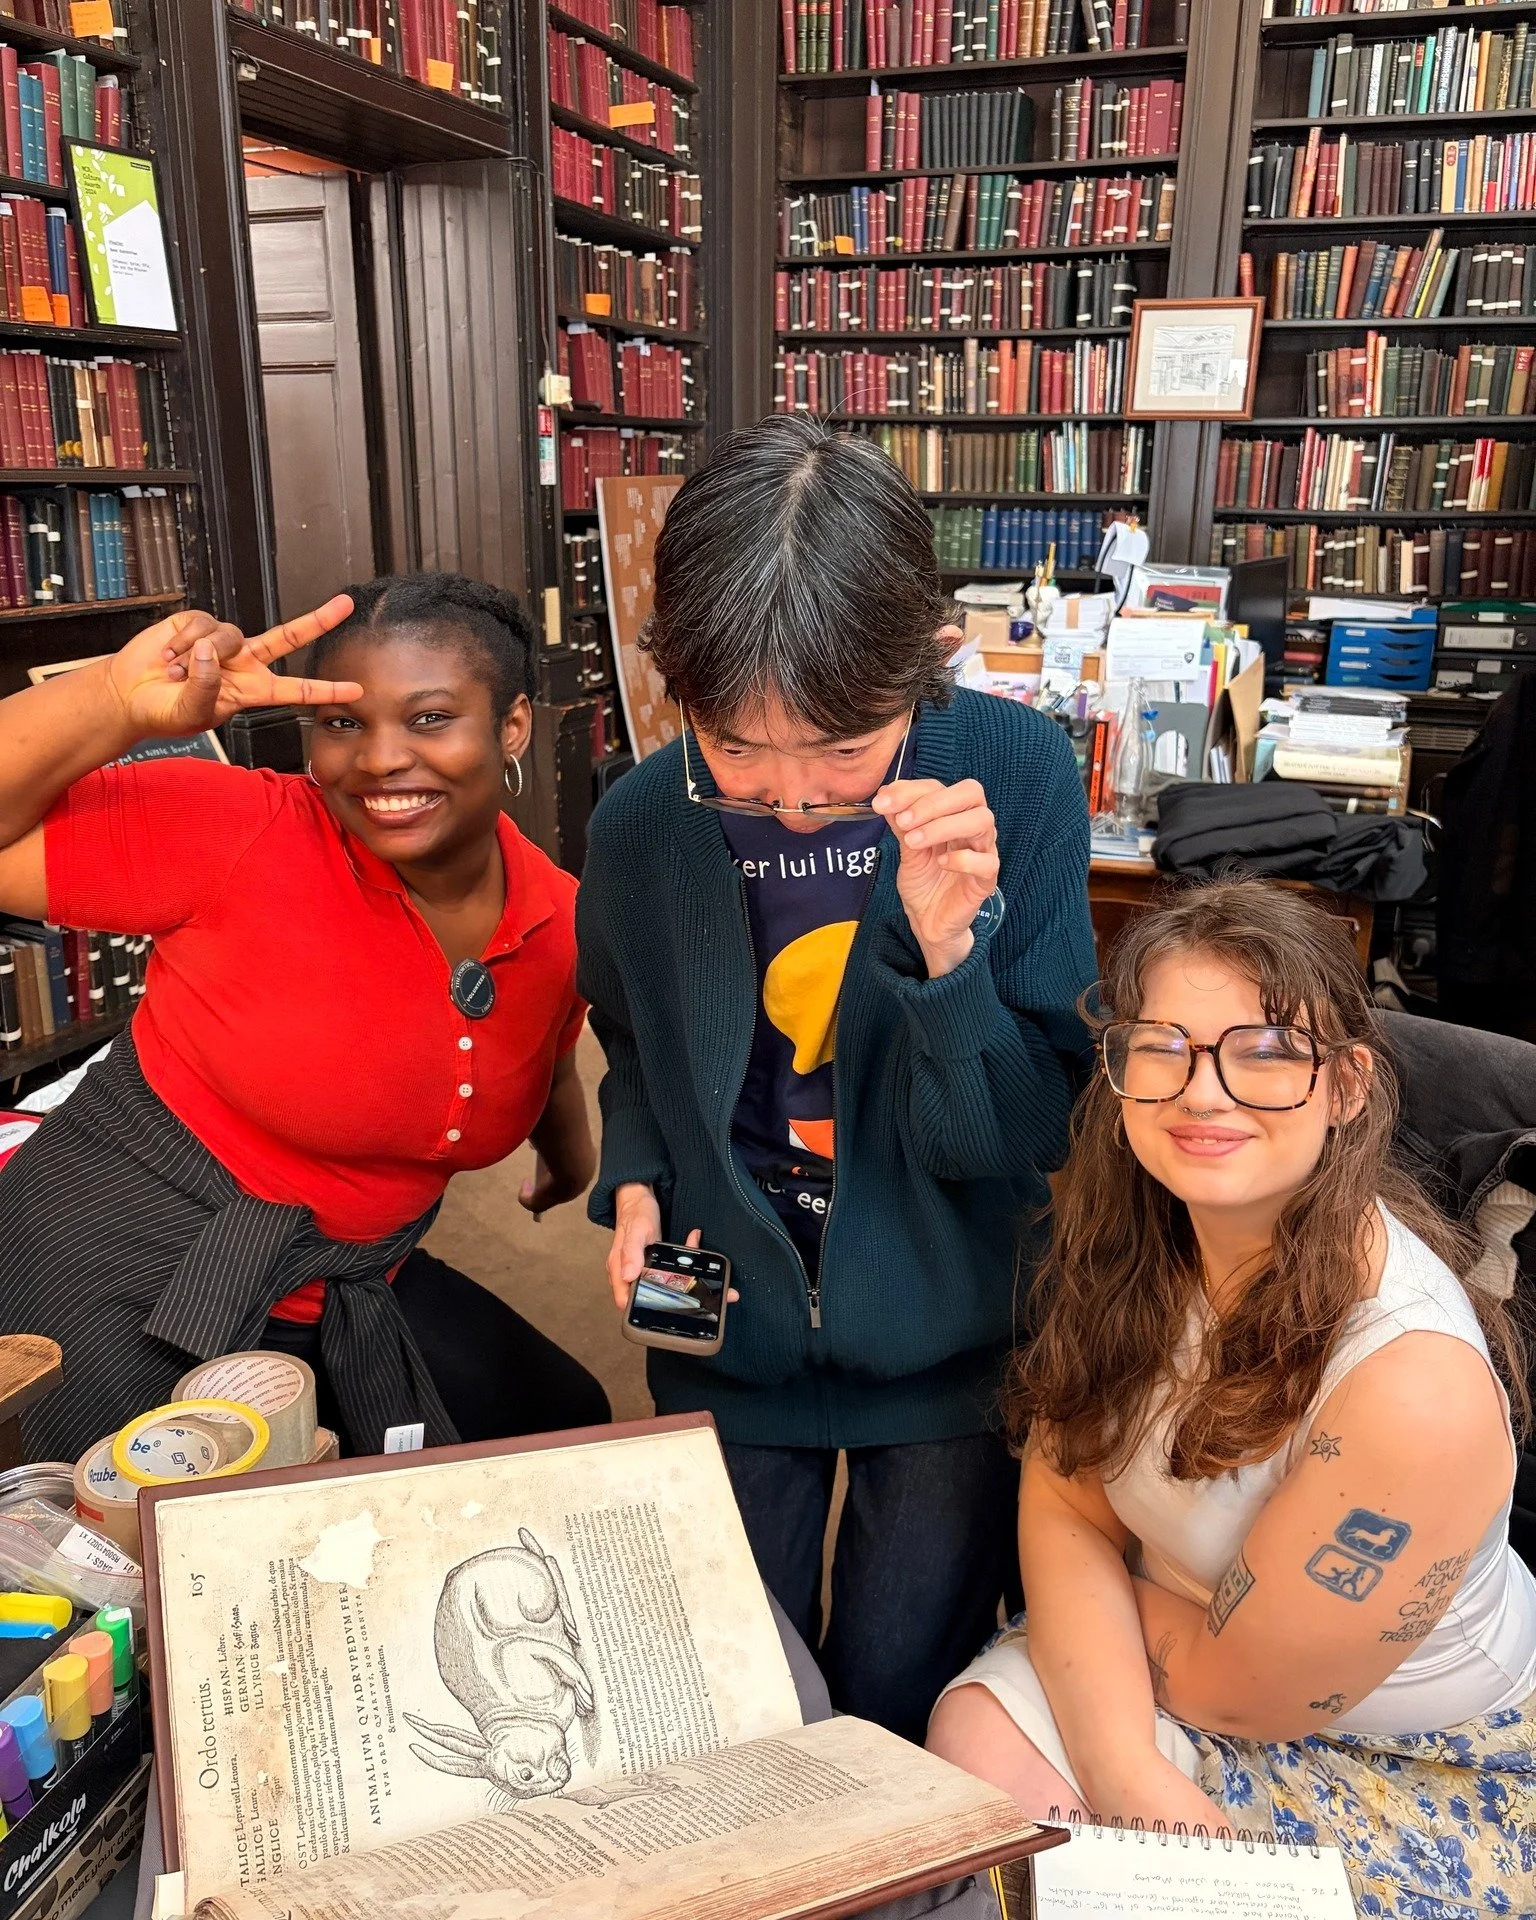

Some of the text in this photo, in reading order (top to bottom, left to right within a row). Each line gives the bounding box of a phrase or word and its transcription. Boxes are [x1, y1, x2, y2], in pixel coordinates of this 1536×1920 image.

[779, 852, 816, 879] lui
[797, 1192, 831, 1214] ee
[269, 1576, 275, 1584] de
[270, 1561, 279, 1575] quo
[288, 1558, 296, 1582] reliqua
[191, 1573, 205, 1596] 105
[270, 1585, 278, 1607] orbis,
[356, 1595, 367, 1641] CORNVTA
[275, 1628, 283, 1653] animal
[297, 1644, 308, 1673] pedibus
[310, 1658, 318, 1678] capite
[250, 1654, 264, 1710] ILLYRICE
[605, 1676, 613, 1694] quem
[627, 1656, 643, 1711] Leporum genus
[324, 1696, 334, 1720] animal
[339, 1582, 380, 1824] ANIMALIVM QVADRVPEDVM FER
[385, 1695, 394, 1723] minima
[194, 1678, 219, 1789] Ordo tertius.
[306, 1709, 314, 1734] Taxus
[613, 1719, 625, 1744] generis
[310, 1734, 315, 1743] ut
[319, 1732, 328, 1757] Vulpi
[622, 1712, 634, 1759] magnitudine
[378, 1735, 387, 1764] ORDO
[291, 1757, 301, 1803] mentionem
[324, 1760, 332, 1793] inferiori
[383, 1772, 391, 1796] RVM
[317, 1791, 325, 1818] colore
[329, 1796, 337, 1817] parte
[235, 1805, 245, 1831] Lepre
[294, 1804, 306, 1838] Leporis
[339, 1801, 349, 1843] ualetudini
[4, 1793, 86, 1892] Chalkola
[332, 1820, 340, 1856] corporis
[342, 1844, 350, 1853] &
[60, 1843, 116, 1911] meet your
